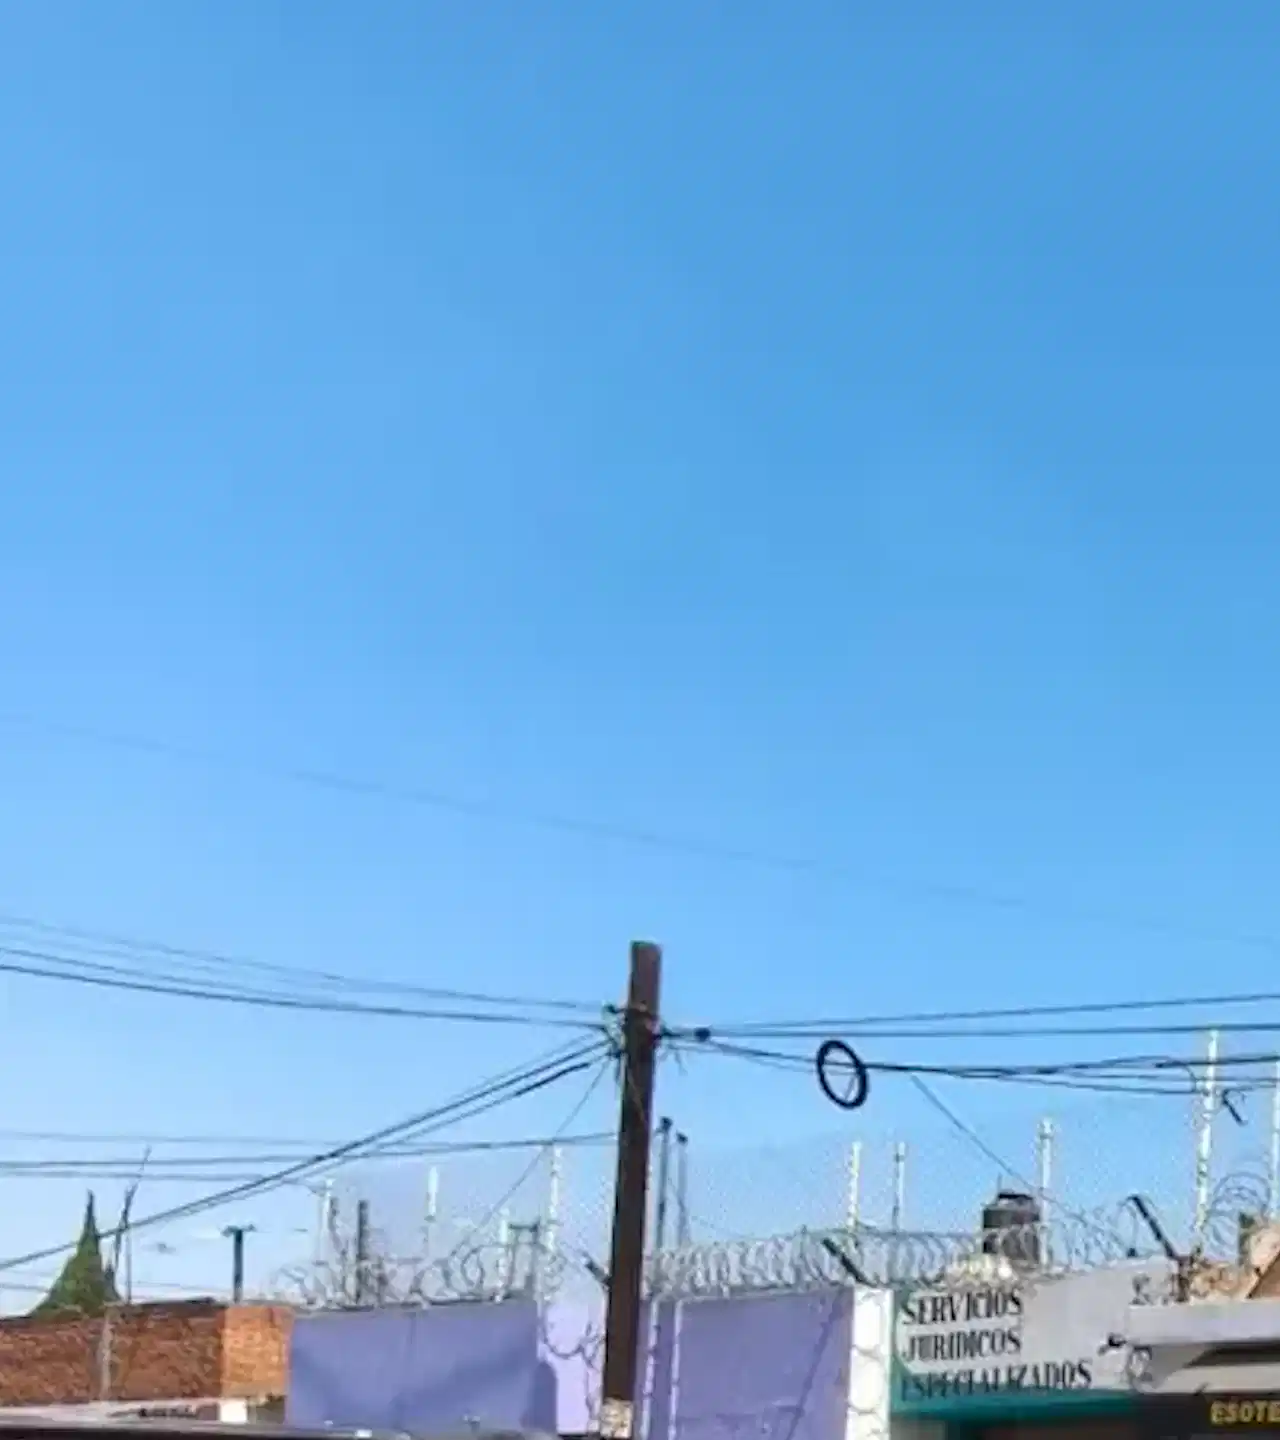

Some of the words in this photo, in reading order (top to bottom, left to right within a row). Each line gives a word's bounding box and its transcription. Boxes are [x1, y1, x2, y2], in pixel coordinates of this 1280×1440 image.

[901, 1287, 1022, 1325] SERVICIOS
[903, 1327, 1021, 1363] JURIDICOS
[902, 1356, 1093, 1401] ESPECIALIZADOS
